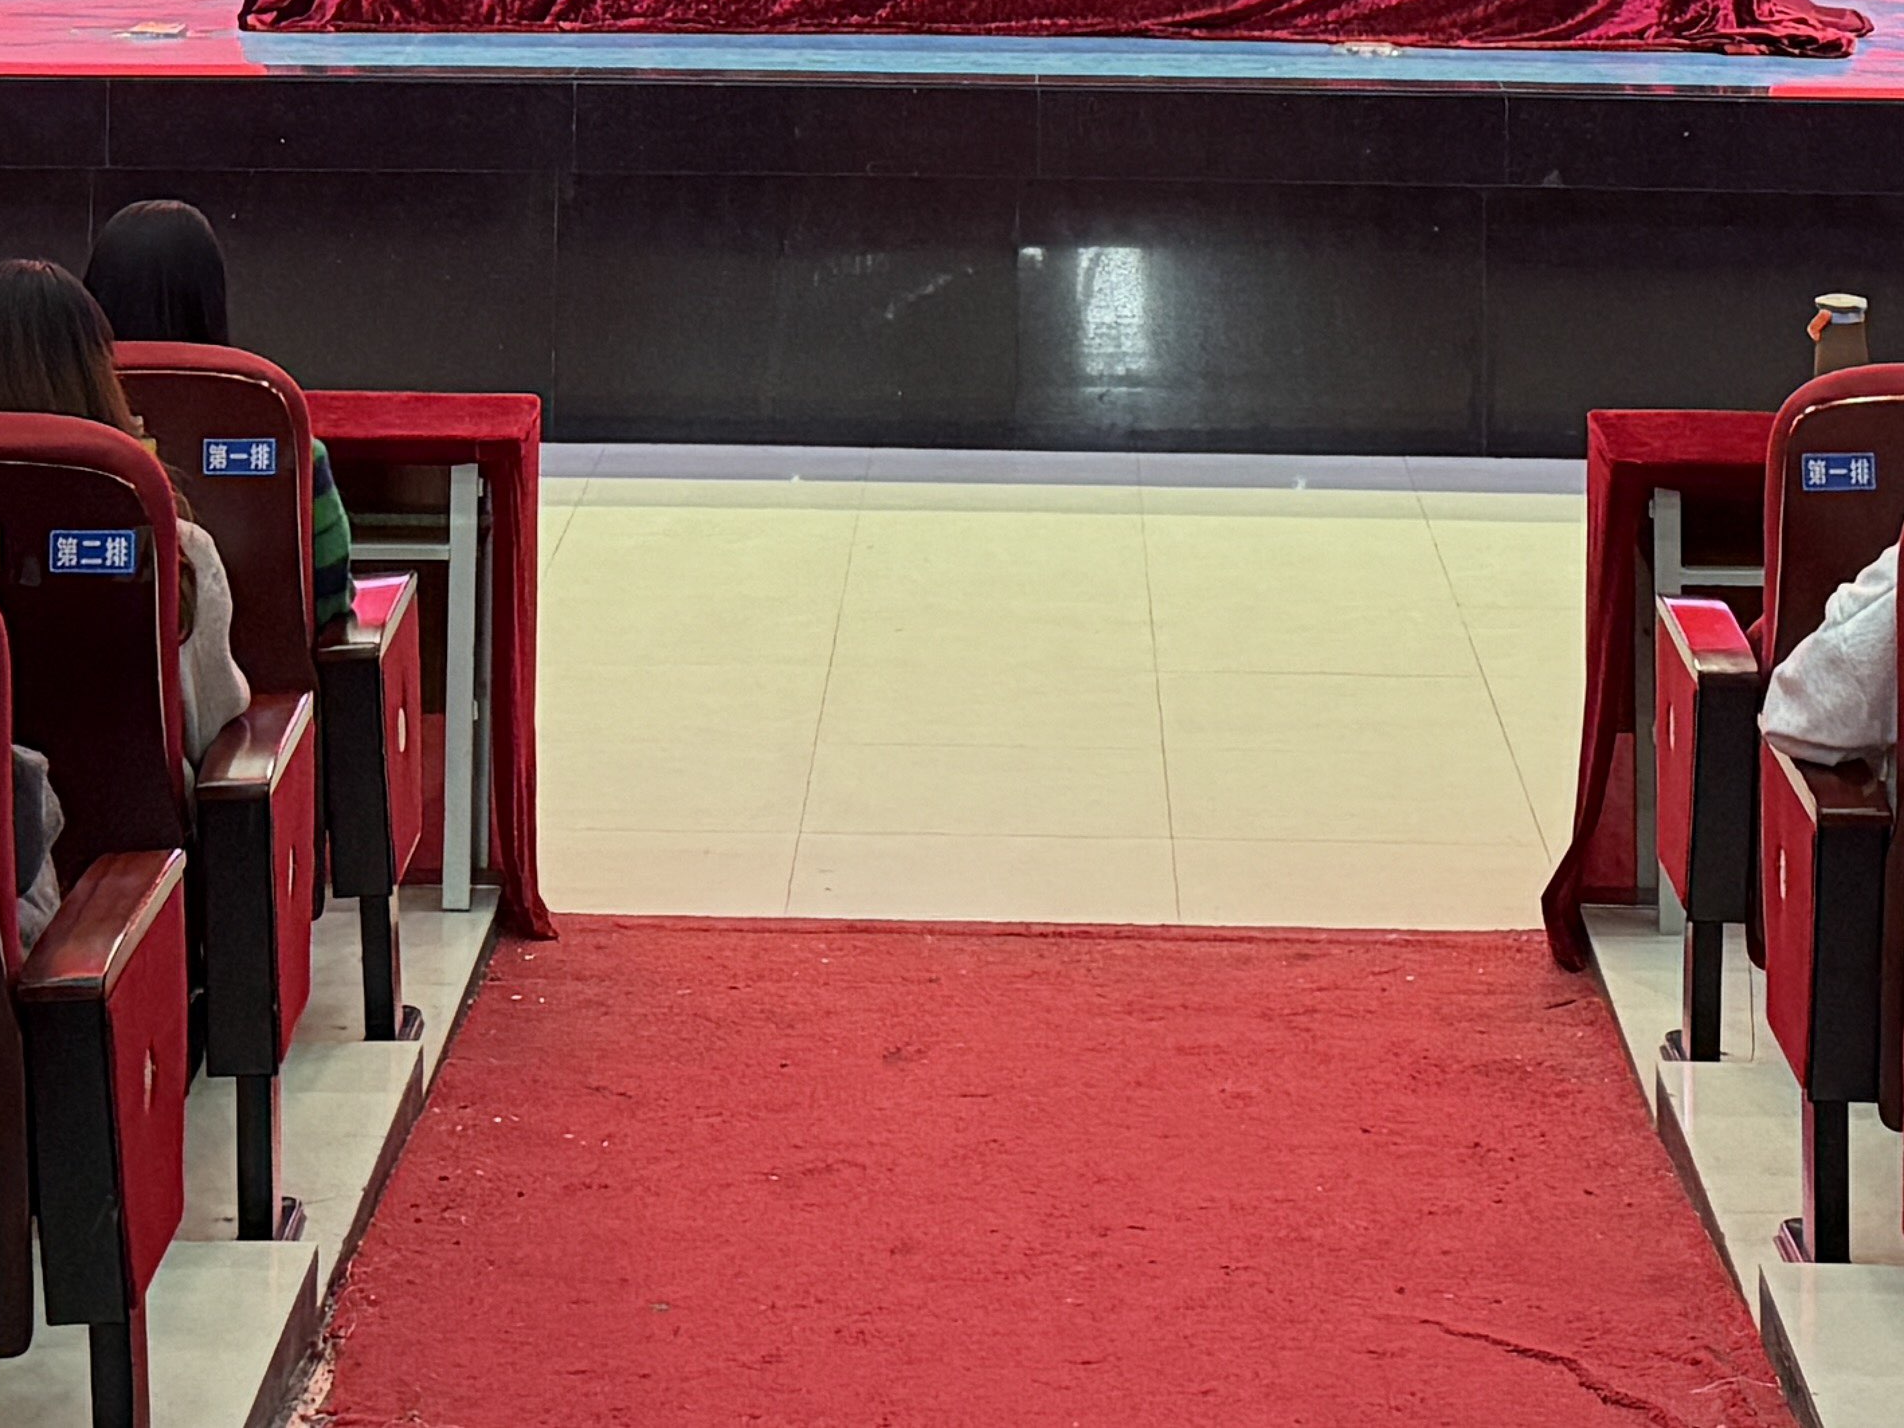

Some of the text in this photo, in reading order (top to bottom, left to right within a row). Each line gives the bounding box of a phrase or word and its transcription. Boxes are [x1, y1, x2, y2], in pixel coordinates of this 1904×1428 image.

[208, 443, 271, 471] 第一排
[1807, 457, 1870, 486] 第一排
[56, 536, 129, 568] 第二排
